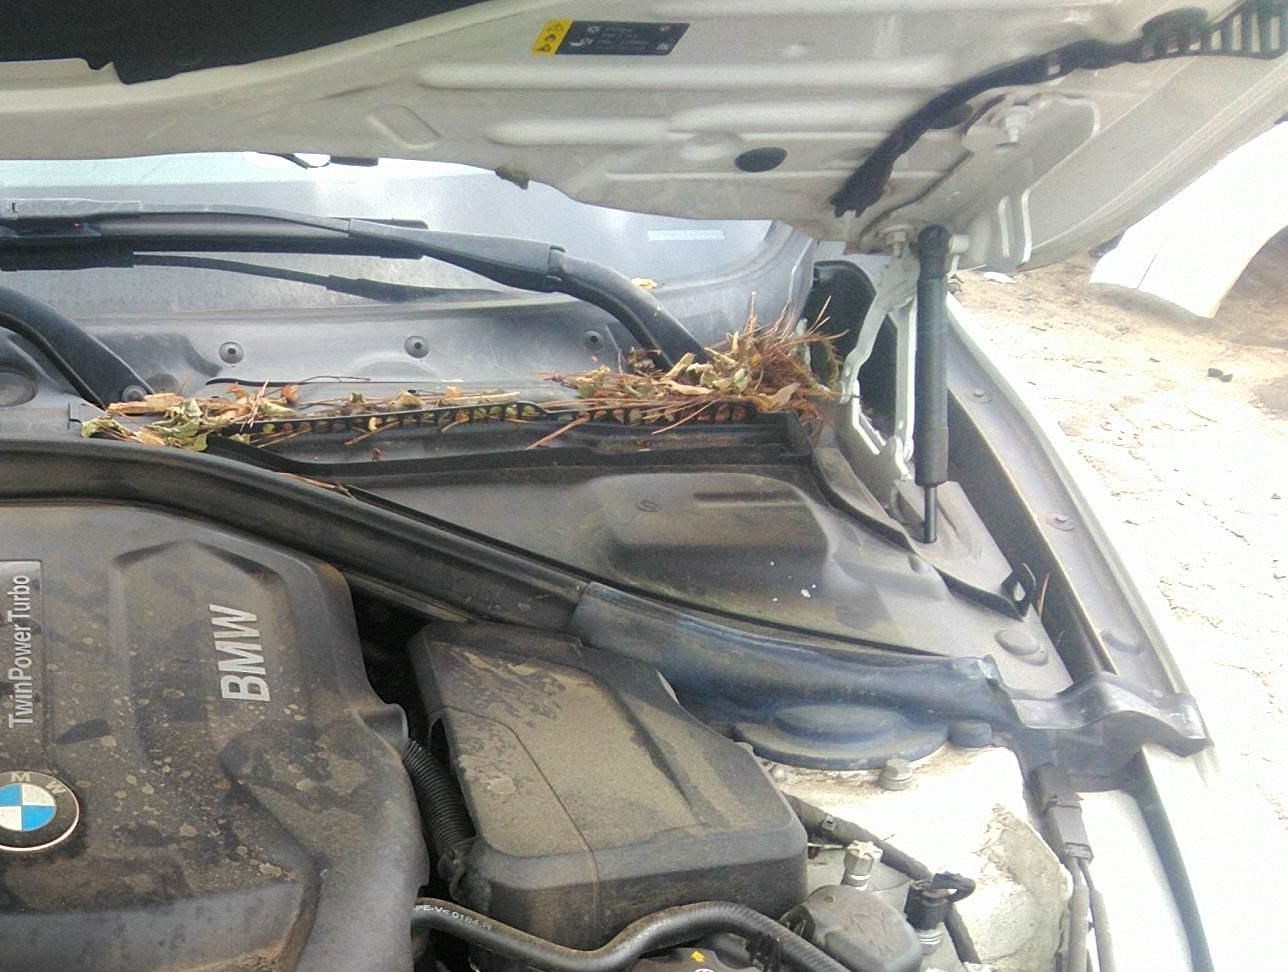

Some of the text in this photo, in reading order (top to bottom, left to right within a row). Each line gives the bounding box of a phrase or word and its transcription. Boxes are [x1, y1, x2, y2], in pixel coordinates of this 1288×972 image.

[8, 575, 33, 729] TwinPower Turbo
[209, 604, 271, 701] BMW
